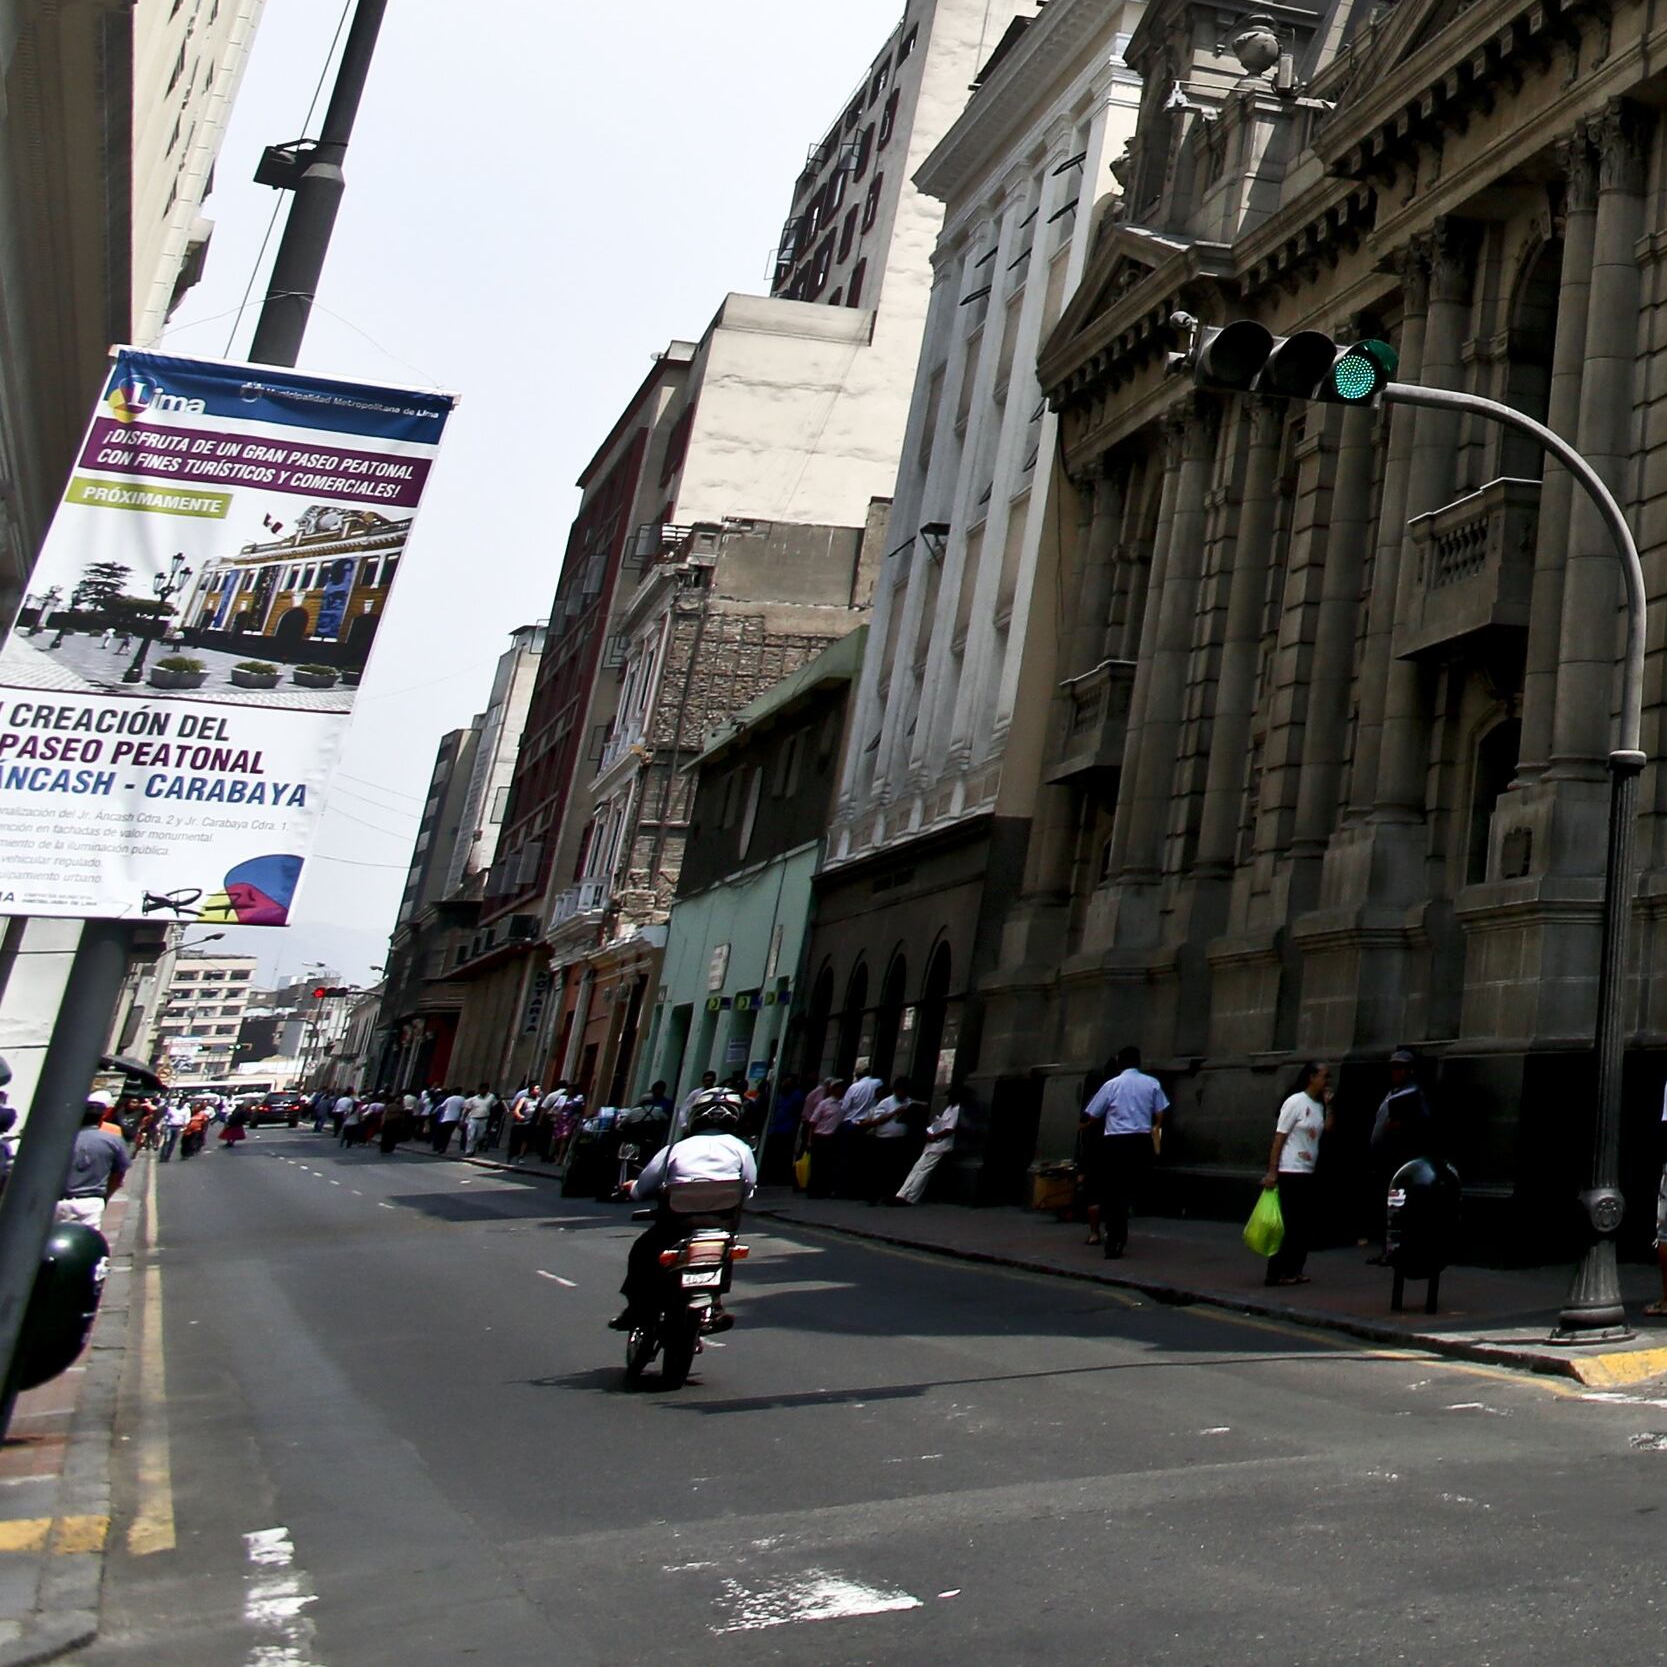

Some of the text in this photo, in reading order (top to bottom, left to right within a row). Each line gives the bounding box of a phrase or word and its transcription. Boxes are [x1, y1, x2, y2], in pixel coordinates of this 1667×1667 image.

[127, 381, 206, 414] Lima
[403, 408, 415, 416] de
[417, 409, 440, 419] Lima
[103, 429, 413, 480] ¡DISFRUTA DE UN GRAN PASEO PEATONAL
[97, 449, 401, 499] CON FINES TURÍSTICOS Y COMERCIALES!
[83, 485, 223, 513] PRÓXIMAMENTE
[9, 703, 230, 741] CREACIÓN DEL
[0, 734, 265, 775] PASEO PEATONAL
[145, 773, 306, 807] CARABAYA
[165, 814, 174, 825] 2
[202, 817, 248, 831] Carabaya
